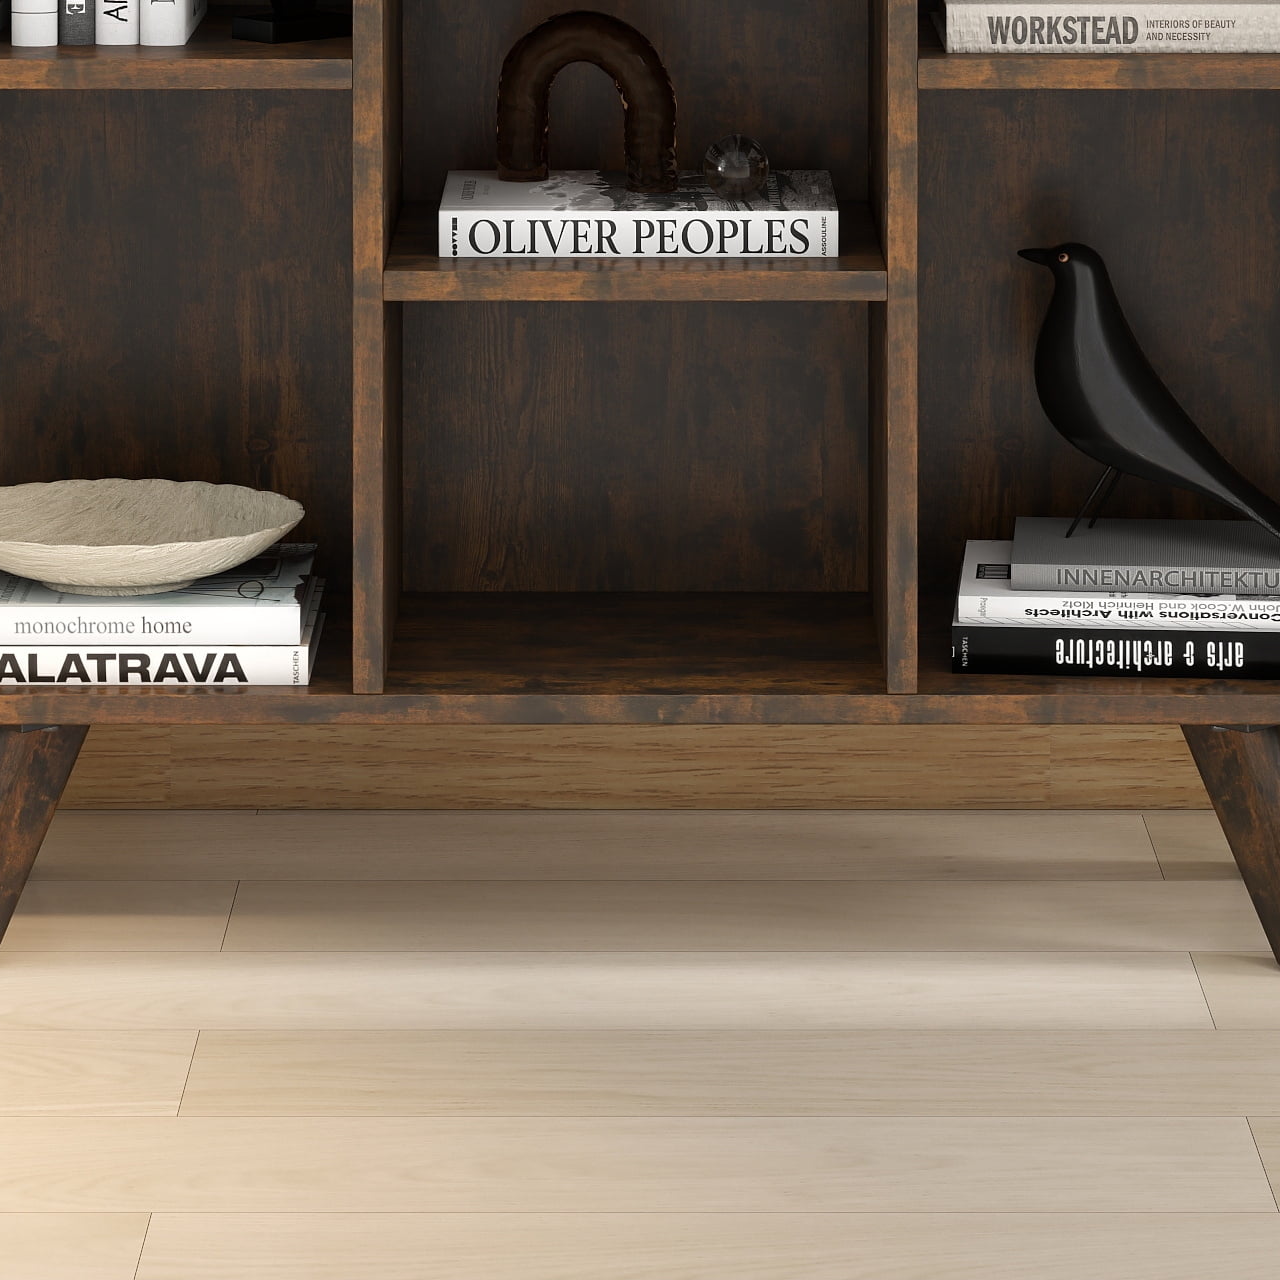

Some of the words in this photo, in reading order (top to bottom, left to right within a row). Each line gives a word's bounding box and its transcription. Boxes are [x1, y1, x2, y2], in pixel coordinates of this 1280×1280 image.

[987, 16, 1139, 45] WORKSTEAD
[1146, 19, 1190, 29] INTERIORS
[1192, 19, 1203, 29] OF
[1204, 19, 1236, 29] BEAUTY
[1146, 32, 1164, 41] AND
[1165, 32, 1211, 41] NECESSITY
[468, 218, 621, 255] OLIVER
[632, 218, 810, 255] PEOPLES
[1062, 600, 1094, 609] Klotz
[1098, 601, 1154, 610] Heinrich
[1159, 602, 1186, 610] and
[1025, 608, 1112, 619] Architects
[1118, 610, 1154, 619] with
[14, 615, 136, 634] monochrome
[141, 615, 192, 634] home
[961, 636, 969, 667] TASCHEN
[1055, 638, 1173, 672] architecture
[1206, 641, 1244, 671] arts
[292, 651, 300, 685] TASCHEN
